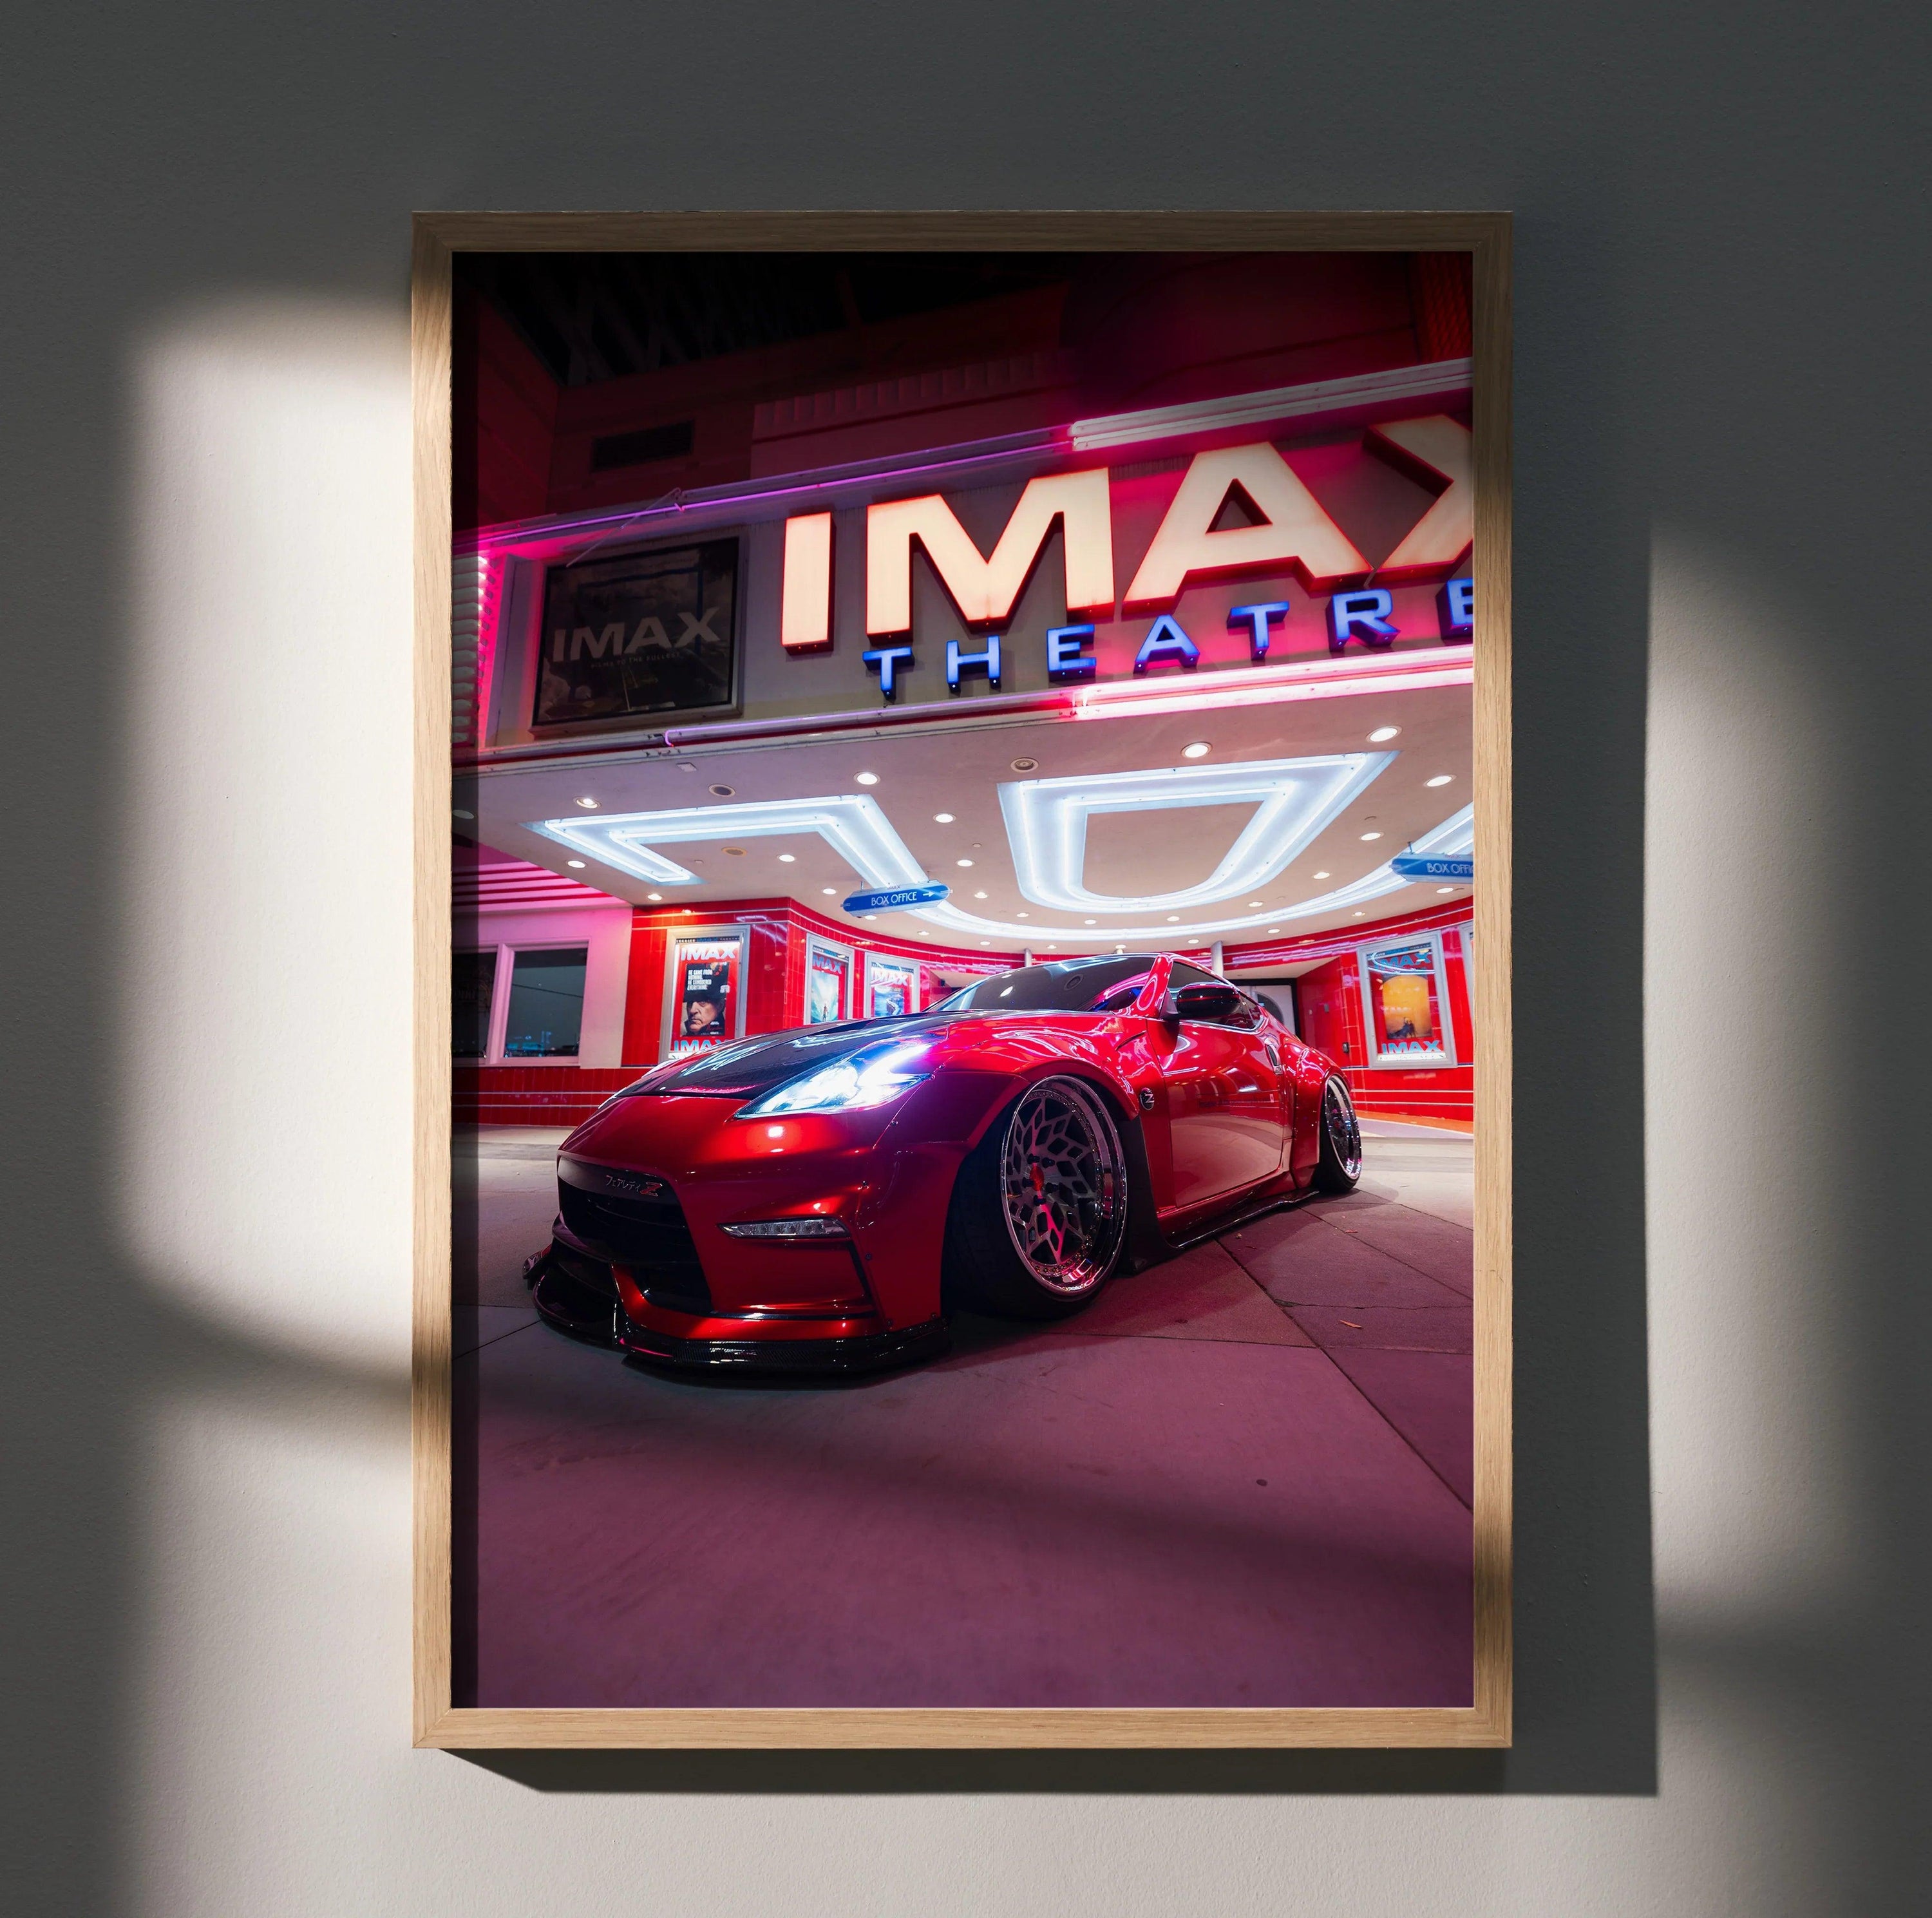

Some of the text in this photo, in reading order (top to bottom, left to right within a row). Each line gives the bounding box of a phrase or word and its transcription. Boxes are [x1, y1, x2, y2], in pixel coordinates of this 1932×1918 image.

[553, 607, 721, 663] IMAX
[1426, 862, 1450, 873] BOX
[871, 891, 918, 906] BOX OFFICE
[680, 946, 735, 960] IMAX
[1381, 1040, 1441, 1054] IMAX
